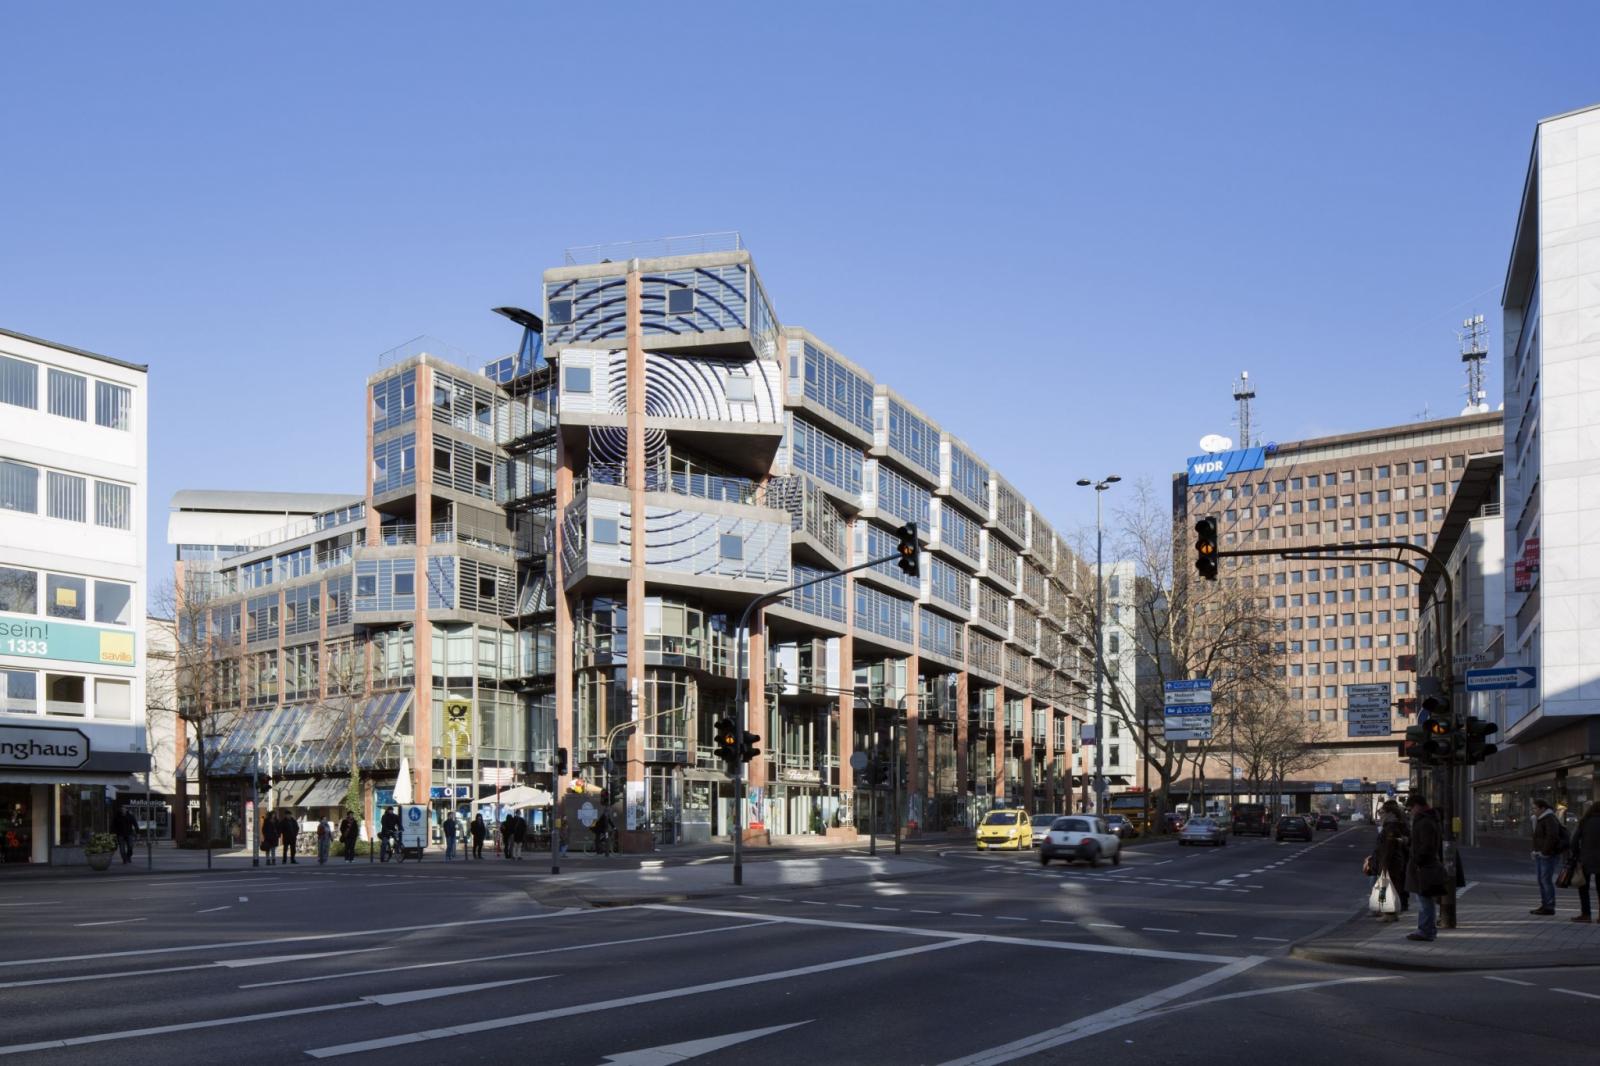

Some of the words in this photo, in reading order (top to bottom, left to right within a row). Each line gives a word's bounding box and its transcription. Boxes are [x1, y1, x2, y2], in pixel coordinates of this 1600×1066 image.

[1194, 461, 1223, 474] WDR
[0, 621, 49, 640] sein!
[7, 639, 48, 655] 1333
[102, 651, 132, 662] saville
[1, 739, 79, 760] nghaus
